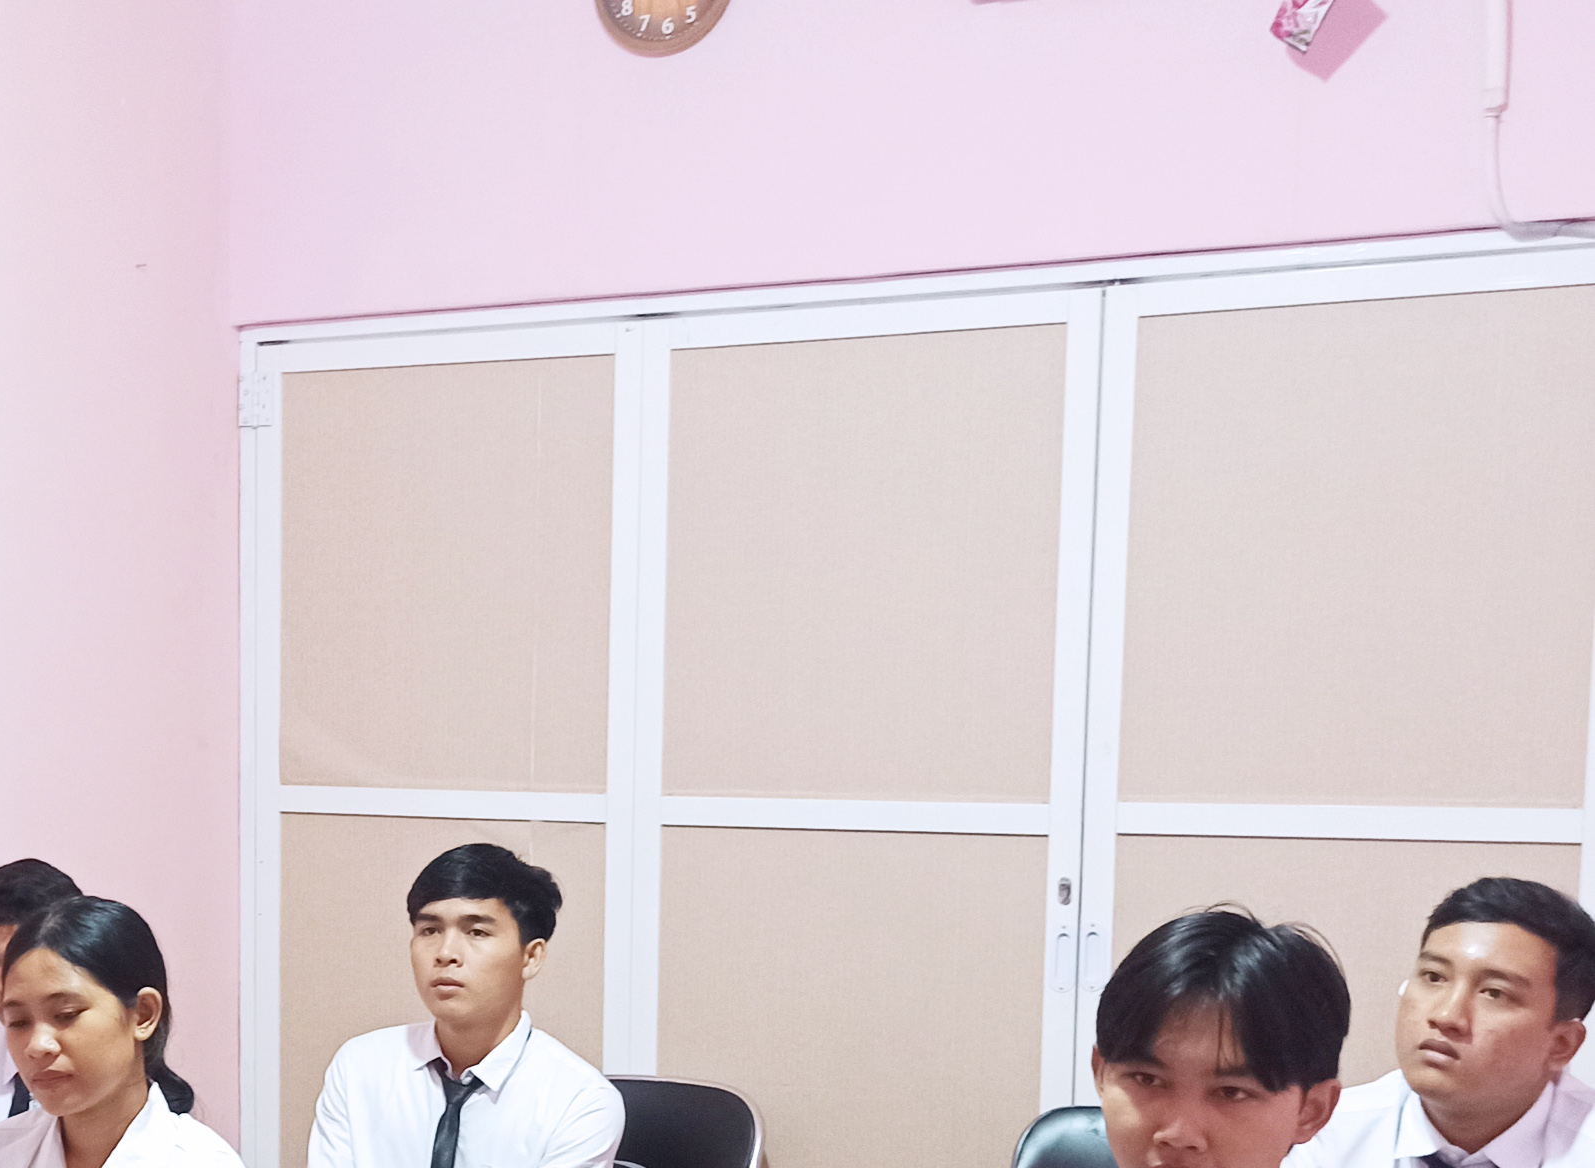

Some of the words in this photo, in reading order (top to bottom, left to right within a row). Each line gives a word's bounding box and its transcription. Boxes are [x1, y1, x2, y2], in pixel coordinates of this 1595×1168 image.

[620, 0, 634, 16] 8
[638, 14, 652, 32] 7
[660, 17, 675, 35] 6
[684, 6, 698, 24] 5
